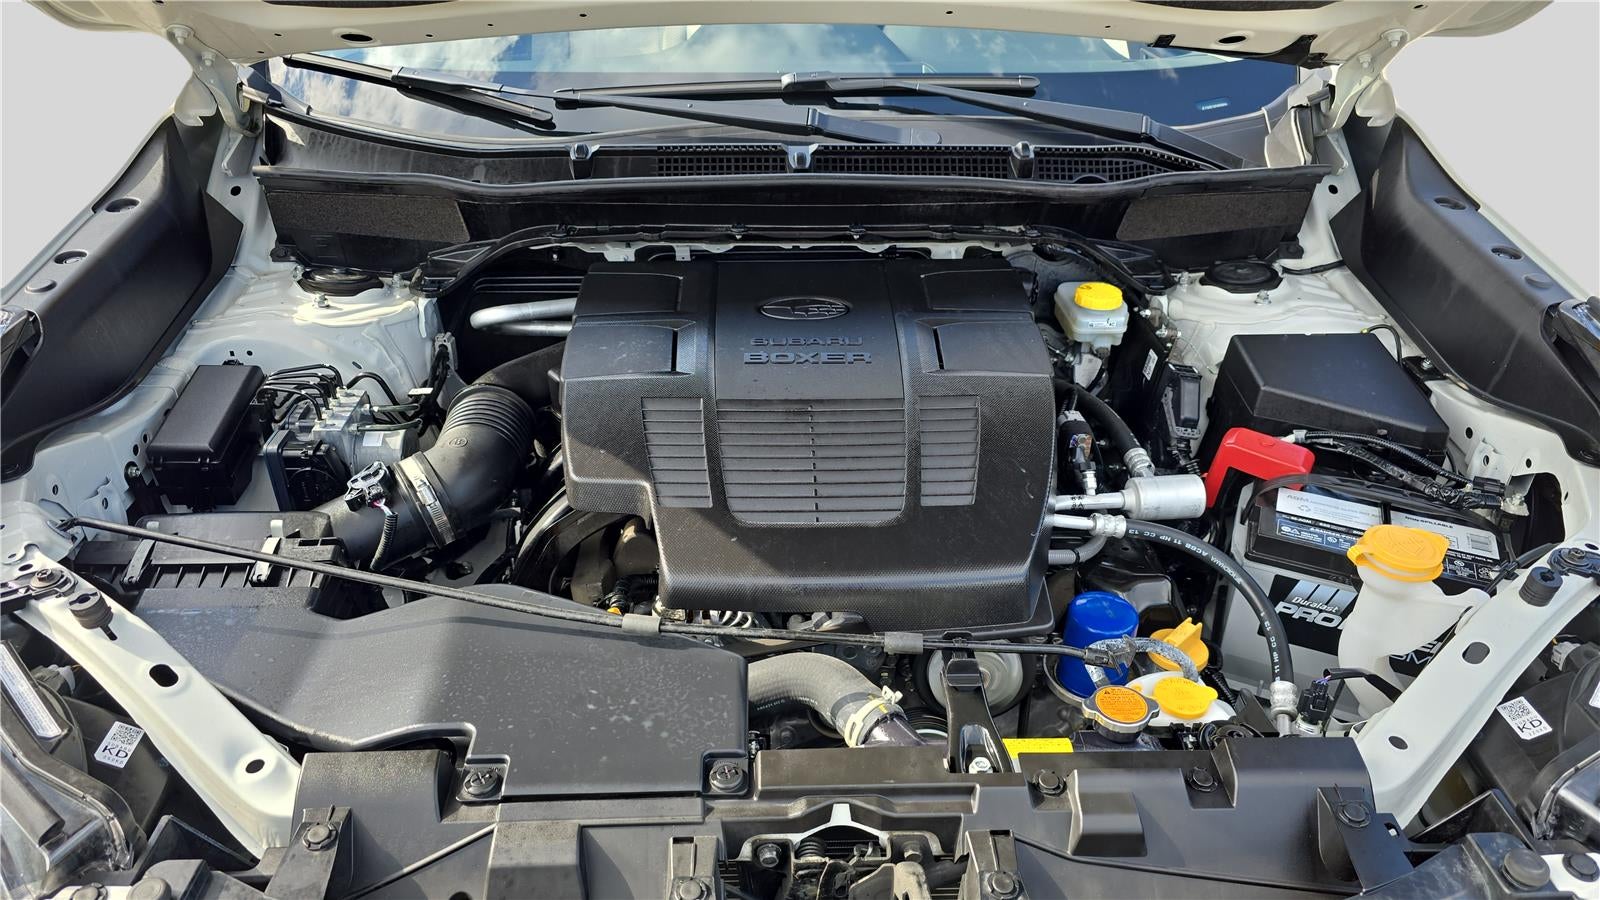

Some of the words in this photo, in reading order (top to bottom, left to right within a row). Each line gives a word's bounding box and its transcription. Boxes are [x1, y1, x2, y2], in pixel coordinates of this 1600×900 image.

[750, 336, 863, 347] SUBARU
[743, 352, 872, 365] BOXER
[1291, 595, 1340, 614] Duralast
[1274, 601, 1346, 630] PRO
[1517, 718, 1543, 733] KD
[102, 745, 128, 759] KD
